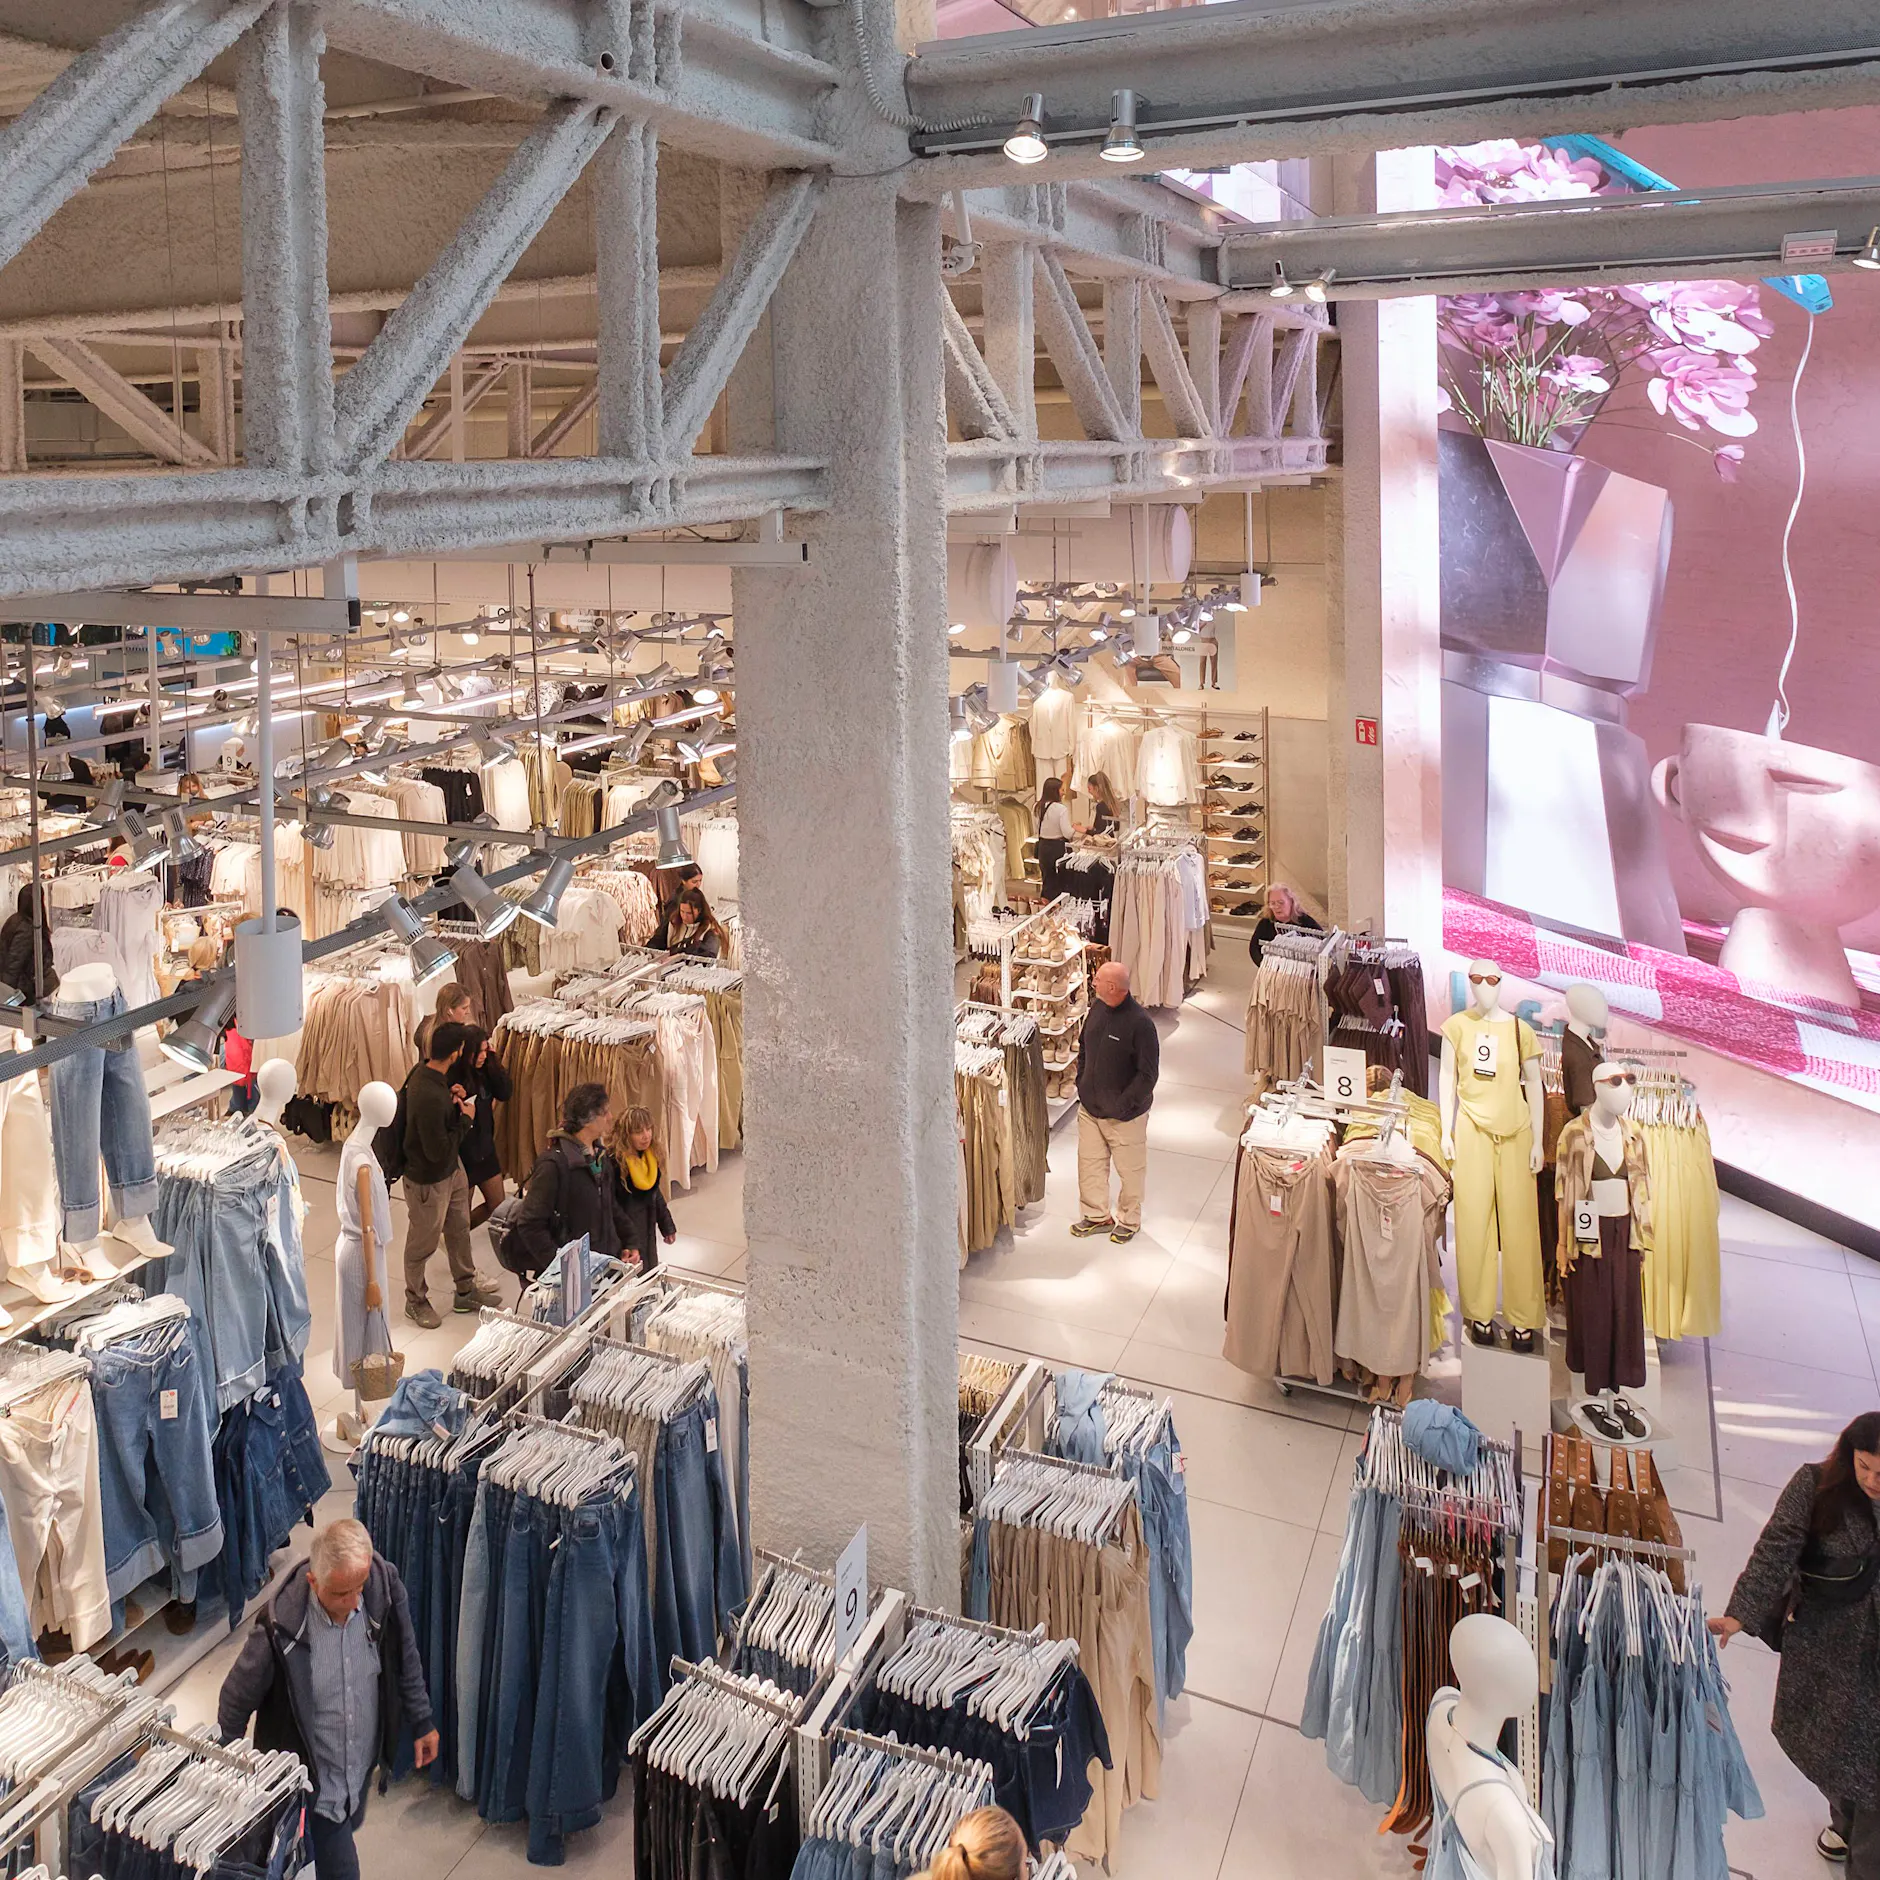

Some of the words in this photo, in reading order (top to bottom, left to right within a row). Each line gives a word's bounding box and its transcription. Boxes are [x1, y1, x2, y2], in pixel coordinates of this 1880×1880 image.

[226, 756, 233, 767] 9
[1478, 1045, 1491, 1062] 9
[1337, 1076, 1353, 1097] 8
[1579, 1213, 1592, 1230] 9
[845, 1587, 858, 1632] 9
